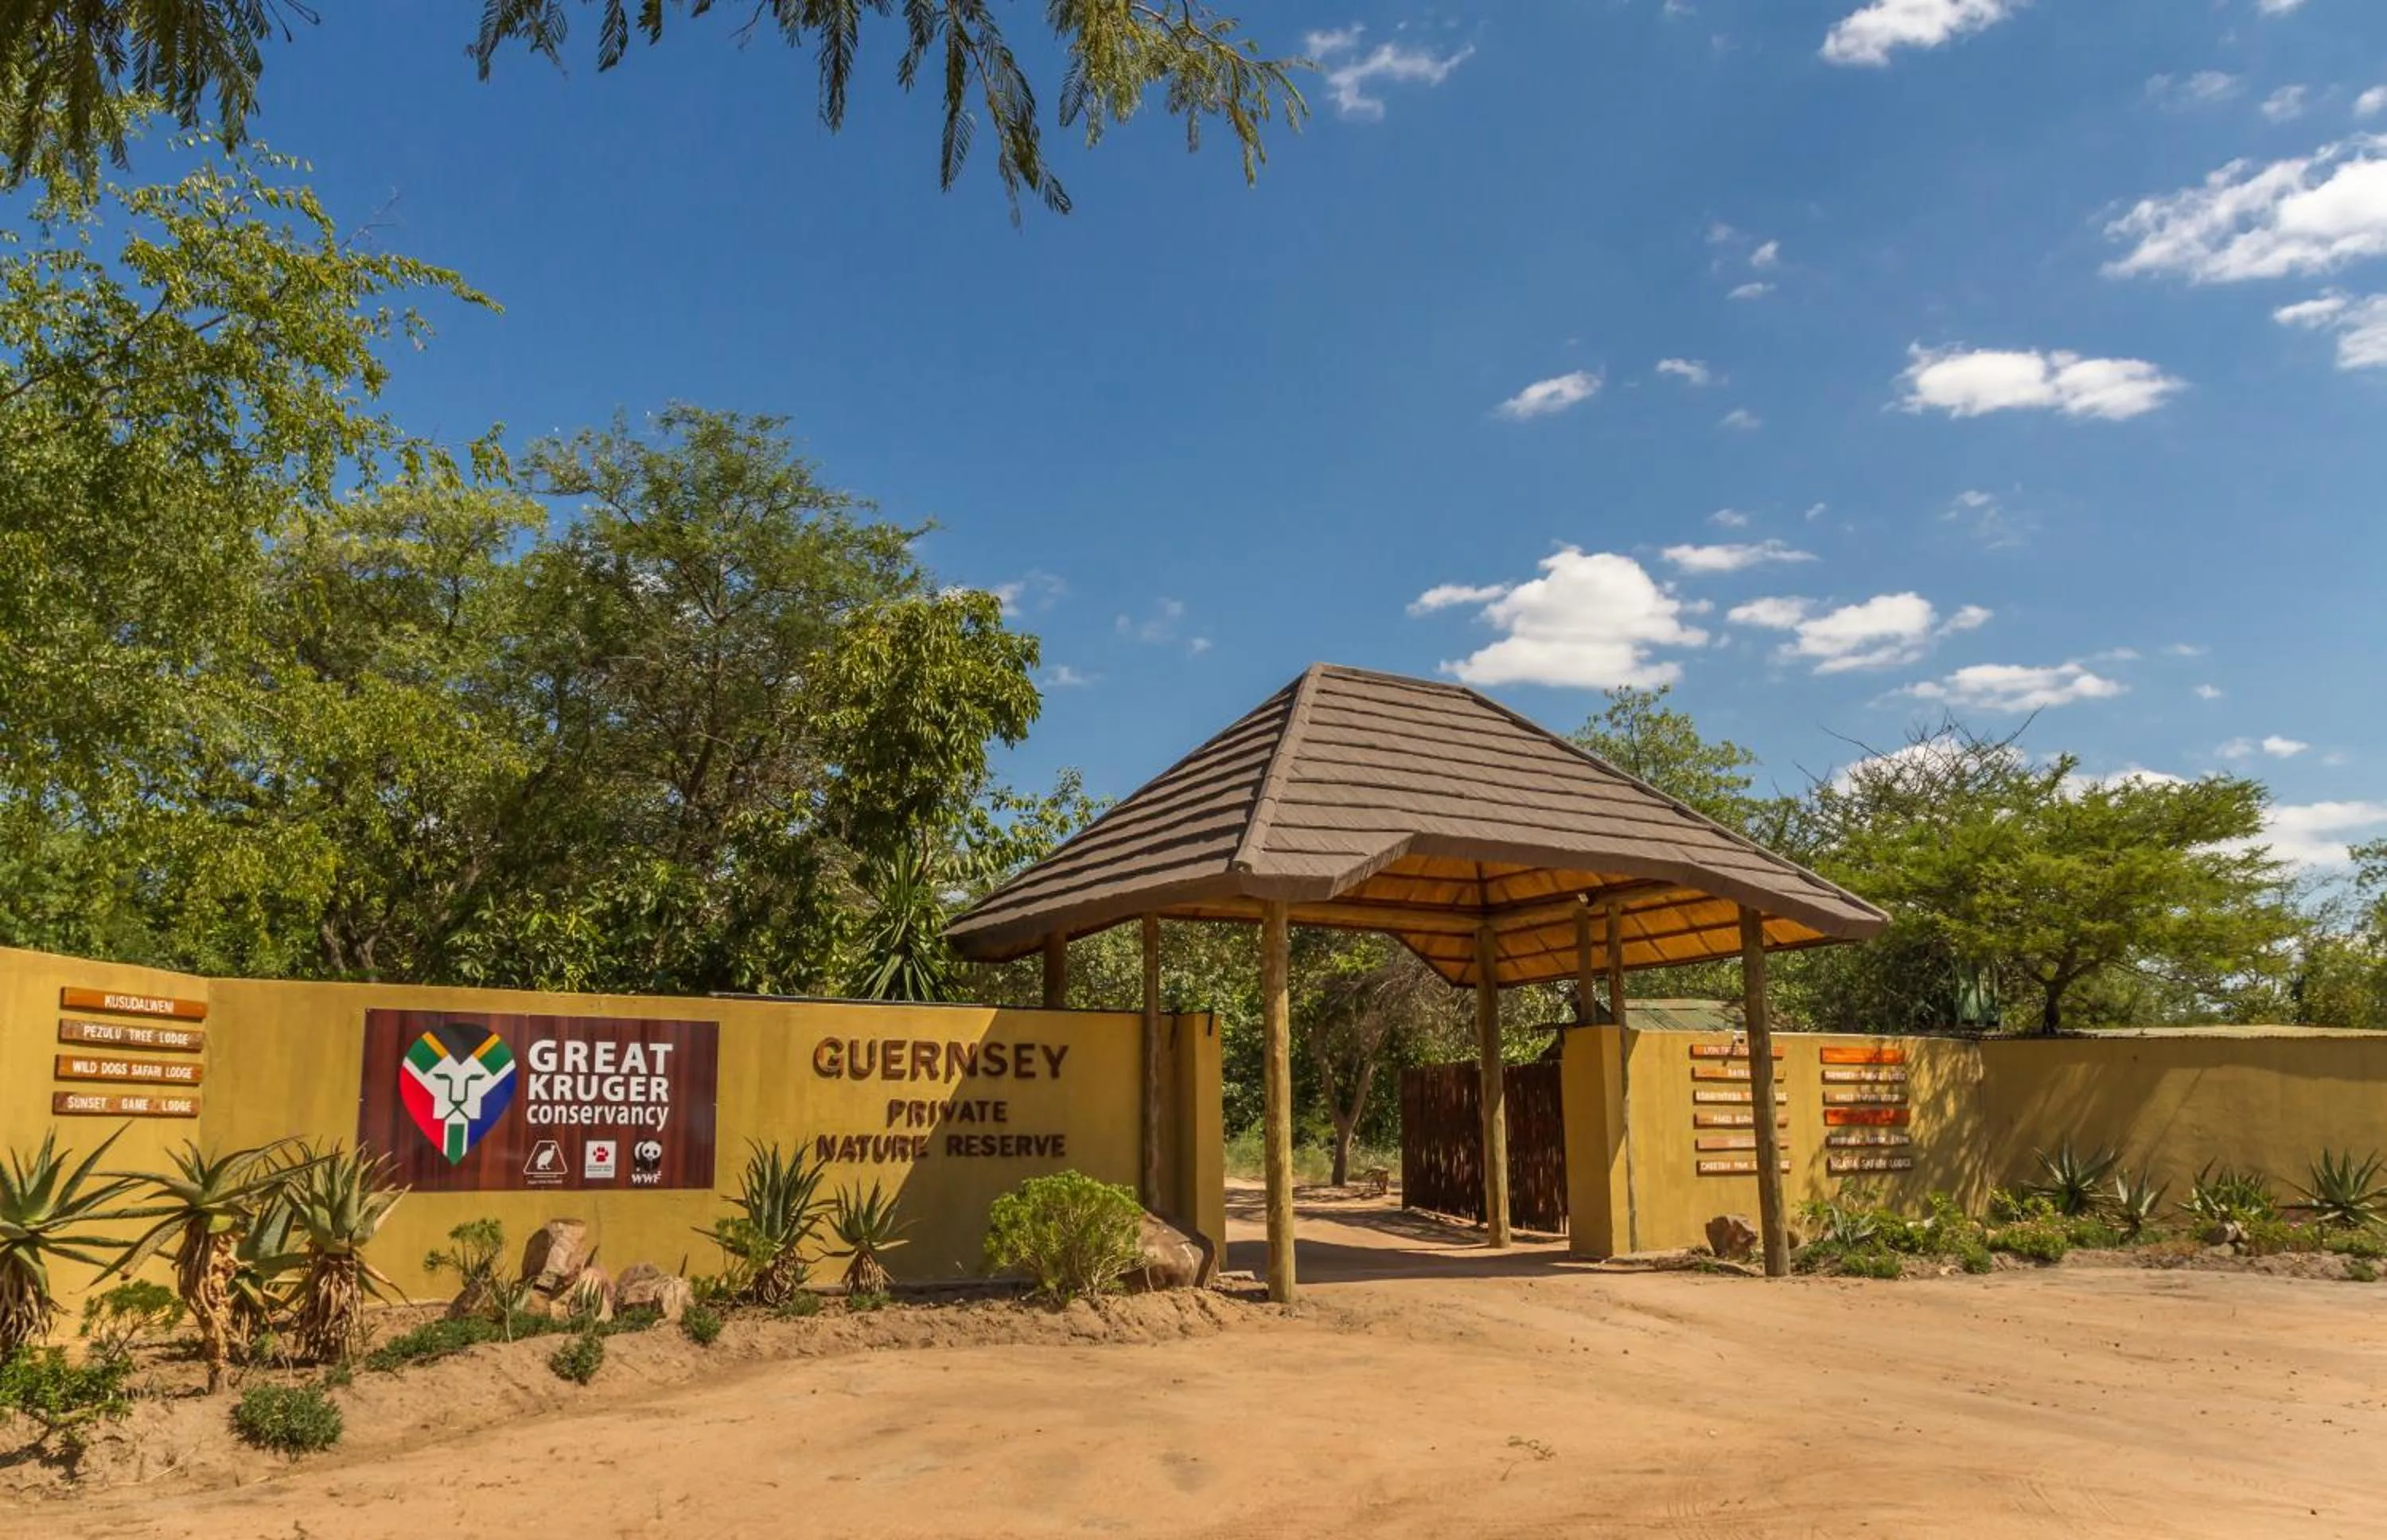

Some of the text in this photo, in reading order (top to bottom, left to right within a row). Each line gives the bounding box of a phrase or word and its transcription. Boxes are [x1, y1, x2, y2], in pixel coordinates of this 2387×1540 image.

[83, 1025, 189, 1045] PEZULU TREE LODGE
[72, 1060, 193, 1079] WILD DOGS SAFARI LODGE
[528, 1040, 674, 1074] GREAT
[812, 1037, 1069, 1083] GUERNSEY
[528, 1075, 669, 1102] KRUGER
[67, 1095, 192, 1112] SUNSET GAME LODGE
[527, 1102, 669, 1132] conservancy
[886, 1099, 1008, 1128] PRIVATE
[816, 1134, 1066, 1163] NATURE RESERVE
[631, 1173, 660, 1184] WWF
